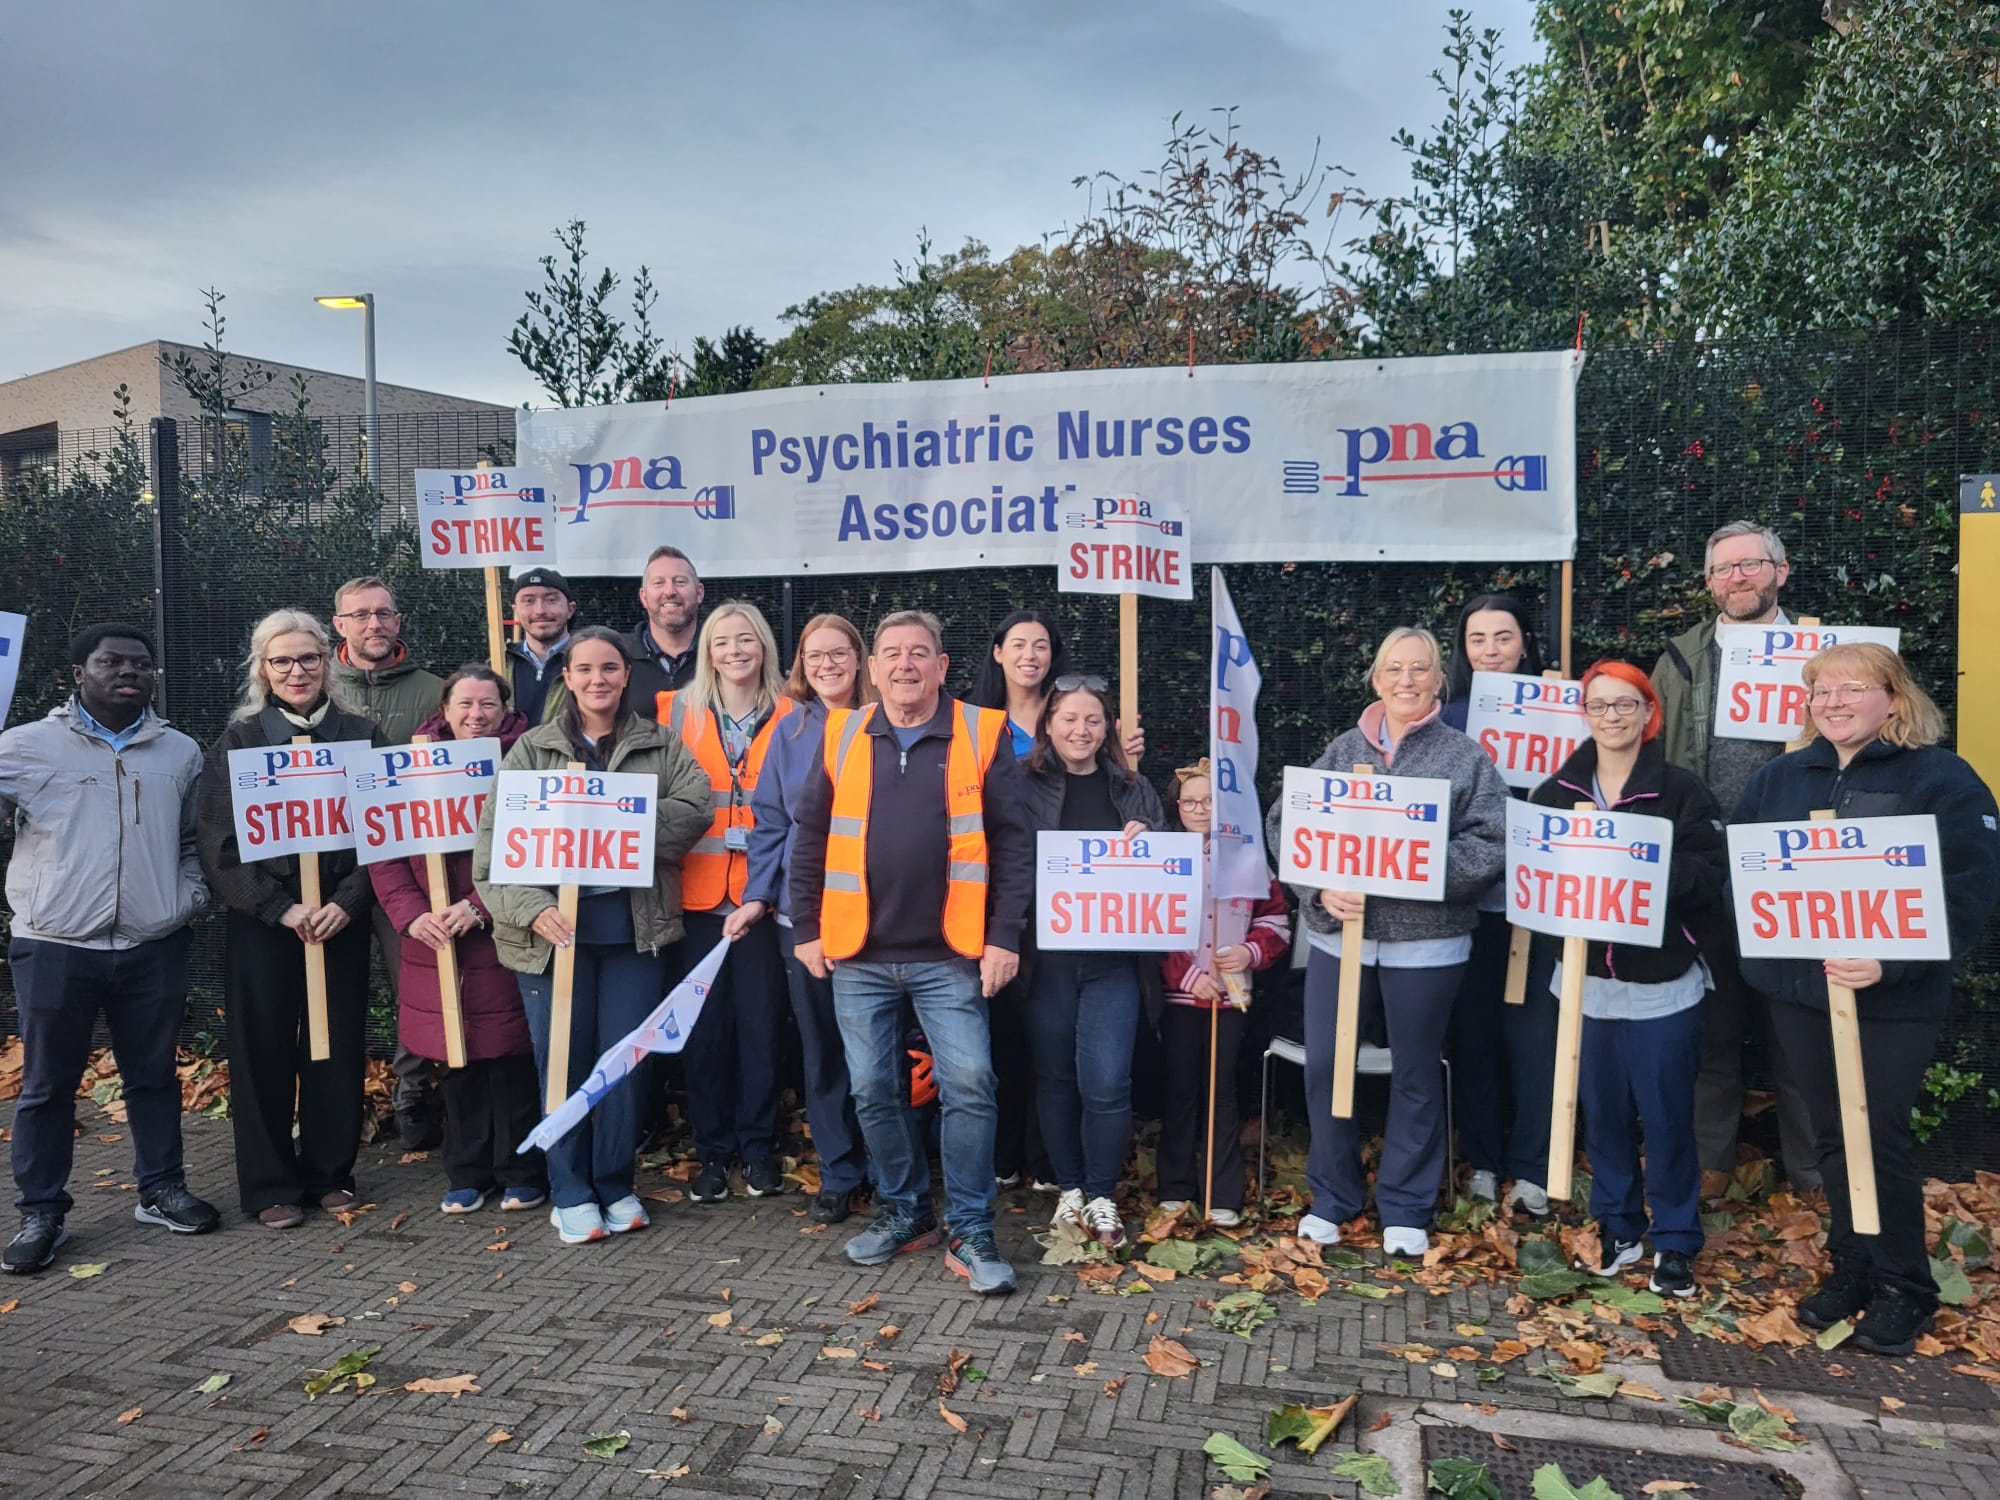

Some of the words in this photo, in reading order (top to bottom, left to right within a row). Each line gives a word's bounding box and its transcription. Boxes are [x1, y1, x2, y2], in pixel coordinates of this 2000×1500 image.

[752, 415, 1034, 483] Psychiatric
[1058, 410, 1251, 460] Nurses
[1336, 421, 1485, 496] pna
[450, 473, 508, 506] pna
[568, 455, 687, 524] pna
[838, 485, 1076, 541] Associat
[1093, 497, 1152, 529] pna
[431, 517, 544, 555] STRIKE
[1070, 543, 1179, 585] STRIKE
[1760, 630, 1838, 666] pna
[1511, 680, 1581, 715] pna
[1729, 681, 1808, 726] STR
[263, 748, 335, 787] pna
[382, 748, 453, 787] pna
[1479, 728, 1576, 775] STRI
[537, 775, 607, 811] pna
[1321, 777, 1393, 814] pna
[246, 797, 354, 845] STRIK
[1539, 813, 1617, 853] pna
[505, 827, 640, 870] STRIKE
[1078, 837, 1151, 875] pna
[1292, 826, 1431, 882] STRIKE
[1774, 826, 1867, 871] pna
[1050, 891, 1187, 935] STRIKE
[1515, 864, 1652, 926] STRIKE
[1751, 889, 1927, 939] STRIKE
